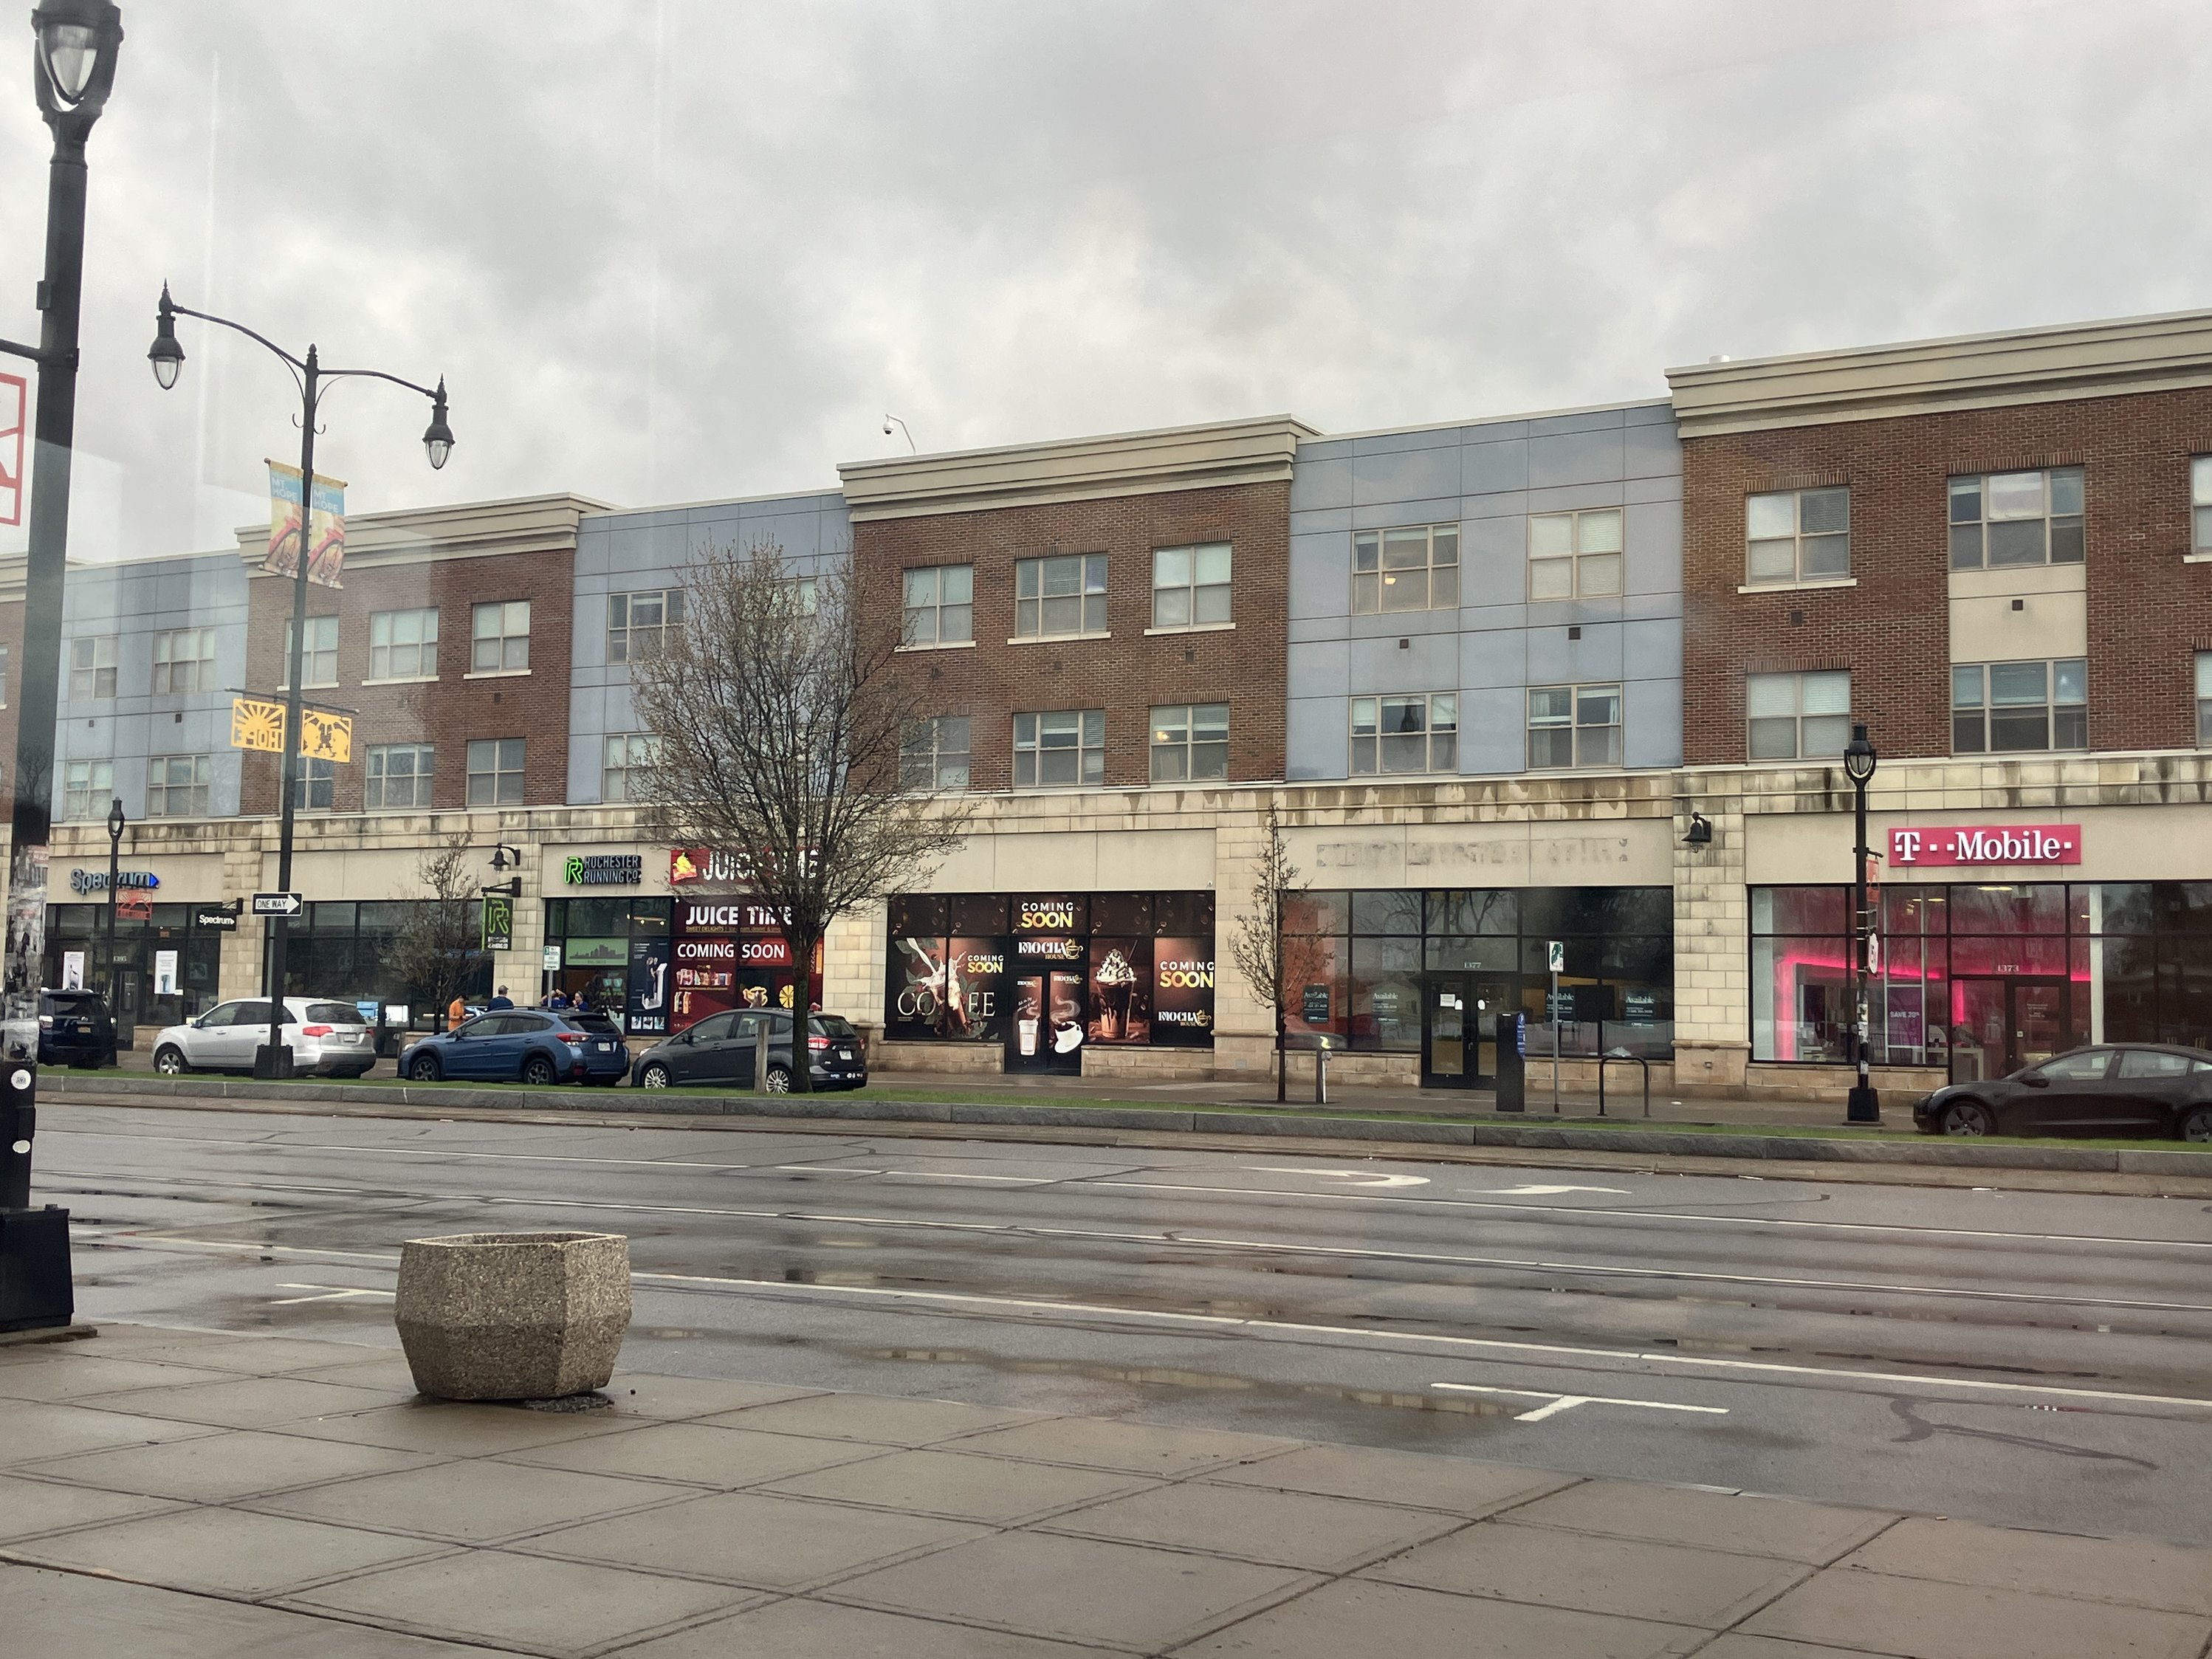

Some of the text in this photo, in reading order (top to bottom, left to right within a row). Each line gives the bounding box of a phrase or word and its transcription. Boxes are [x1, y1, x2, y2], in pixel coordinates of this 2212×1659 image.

[272, 487, 298, 502] HOPE
[313, 499, 339, 513] HOPE
[584, 856, 639, 869] ROCHESTER
[71, 868, 151, 895] Specrum
[584, 870, 625, 884] RUNNING
[257, 899, 286, 909] ONE WAY
[1021, 902, 1074, 912] COMING
[199, 914, 232, 926] Spectrum
[686, 906, 738, 925] JUICE
[1021, 911, 1073, 928] SOON
[677, 944, 785, 959] COMING SOON
[1018, 941, 1068, 958] MOCHA
[967, 961, 1003, 974] SOON
[1160, 961, 1215, 971] COMING
[1998, 964, 2019, 972] 1373
[1159, 971, 1214, 988] SOON
[1373, 992, 1398, 1000] Available
[1625, 995, 1655, 1004] Available
[1158, 1011, 1198, 1026] MOCHA
